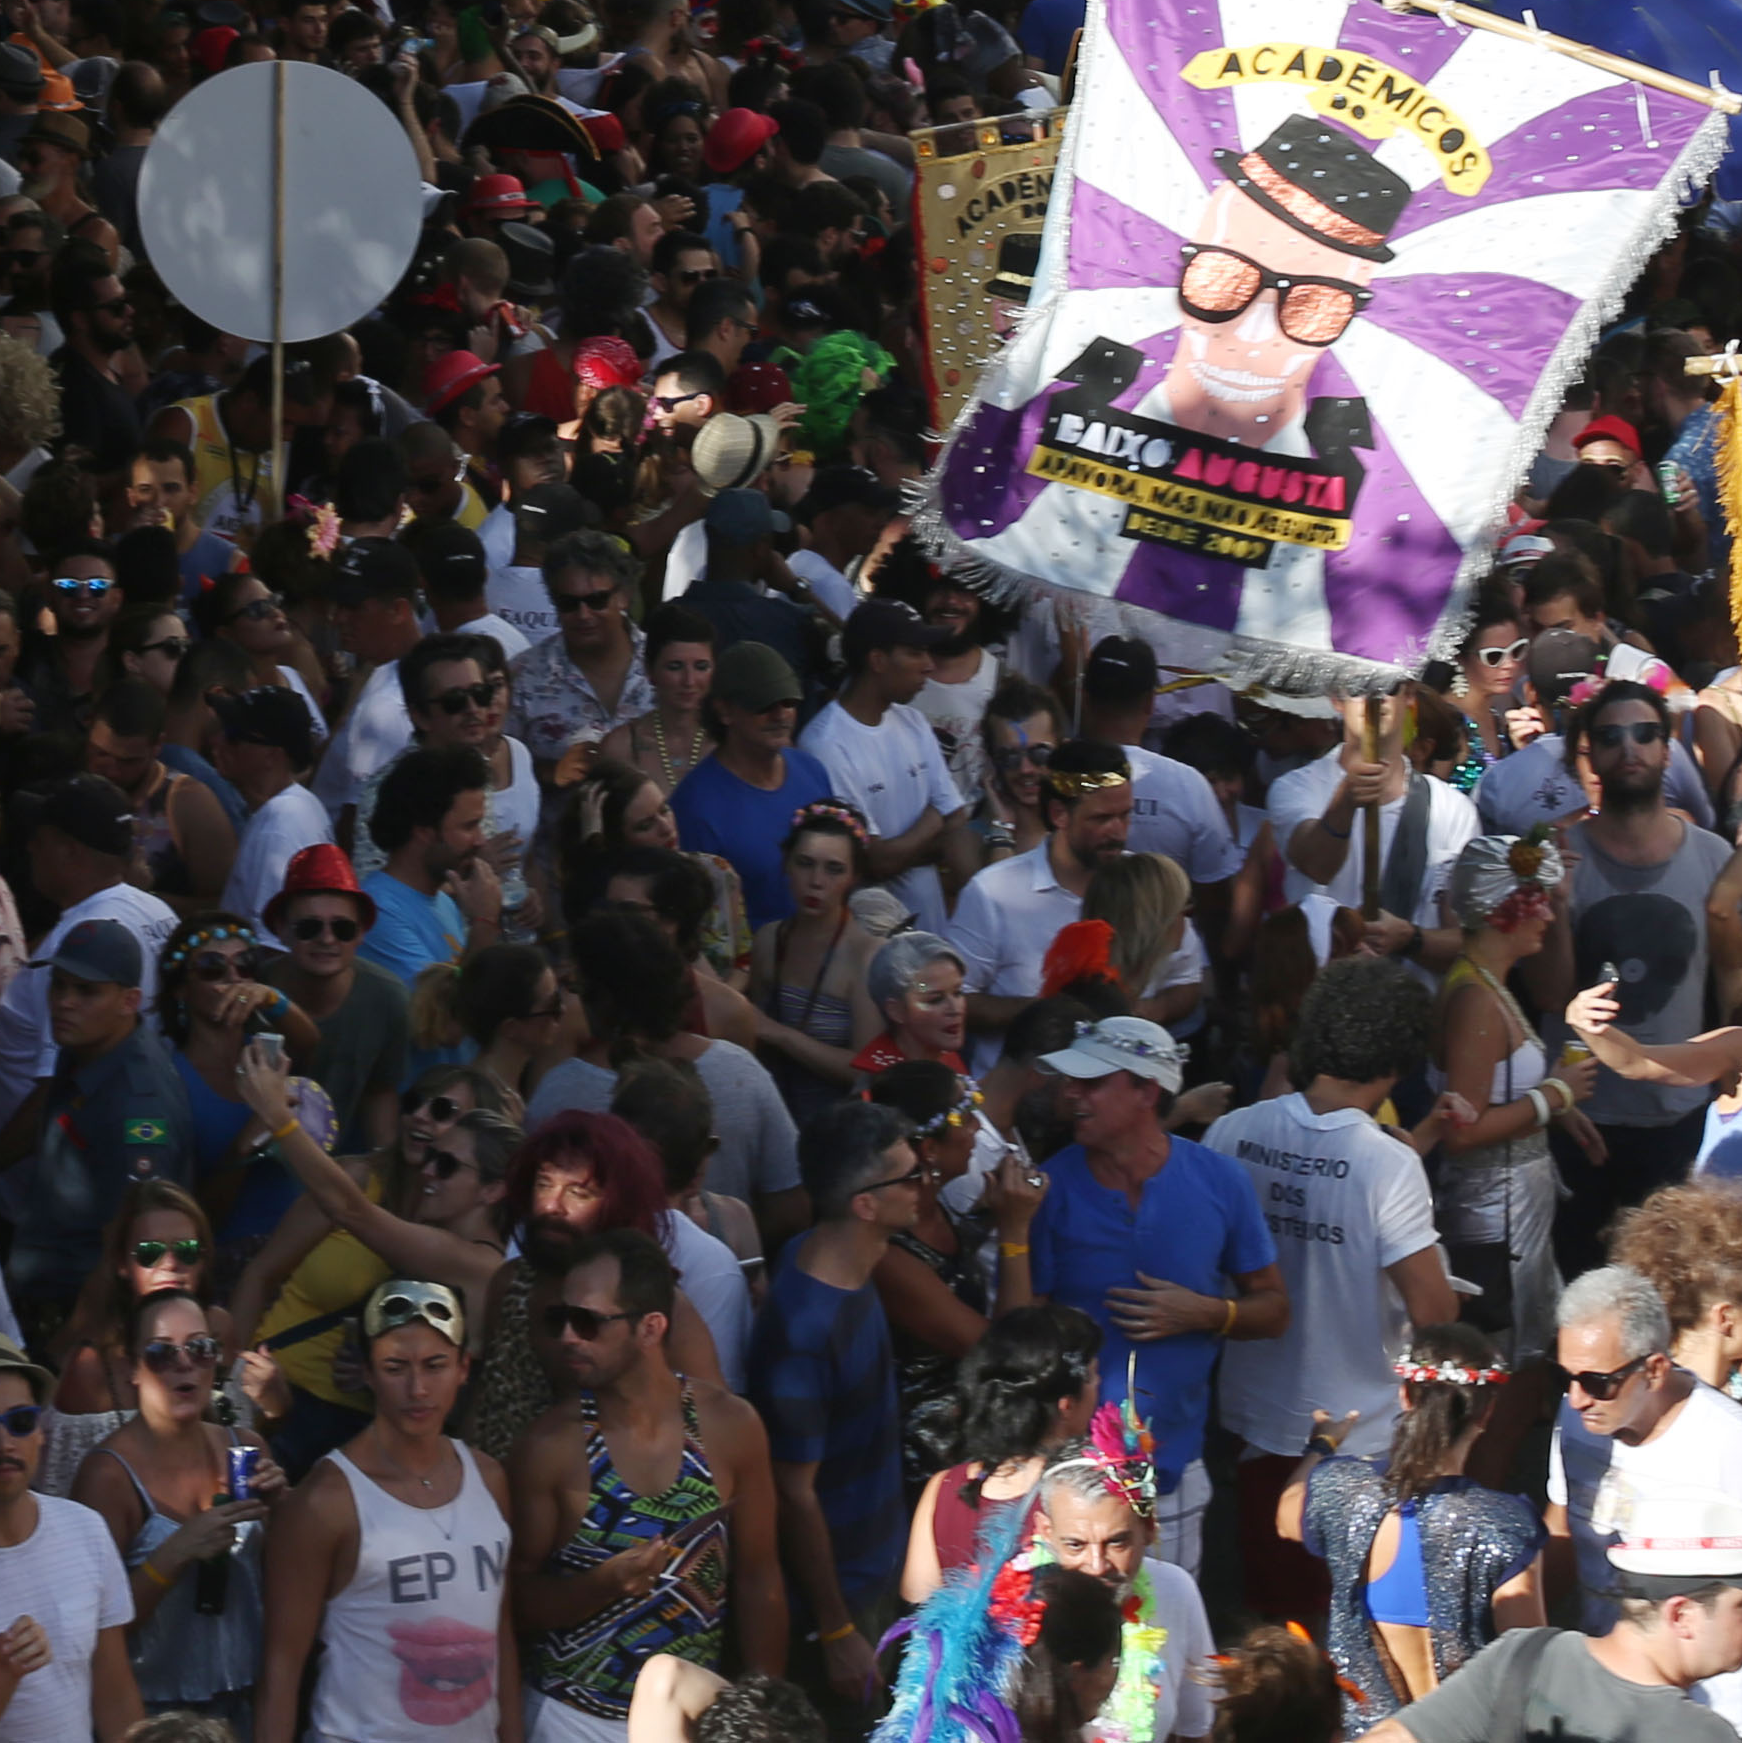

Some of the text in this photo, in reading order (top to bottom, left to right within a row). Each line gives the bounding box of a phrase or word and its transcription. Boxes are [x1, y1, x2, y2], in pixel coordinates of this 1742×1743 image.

[1329, 95, 1366, 120] DO
[1055, 412, 1173, 469] BAIXO
[1173, 447, 1347, 511] AUGUSTA
[1270, 1181, 1307, 1208] DOS
